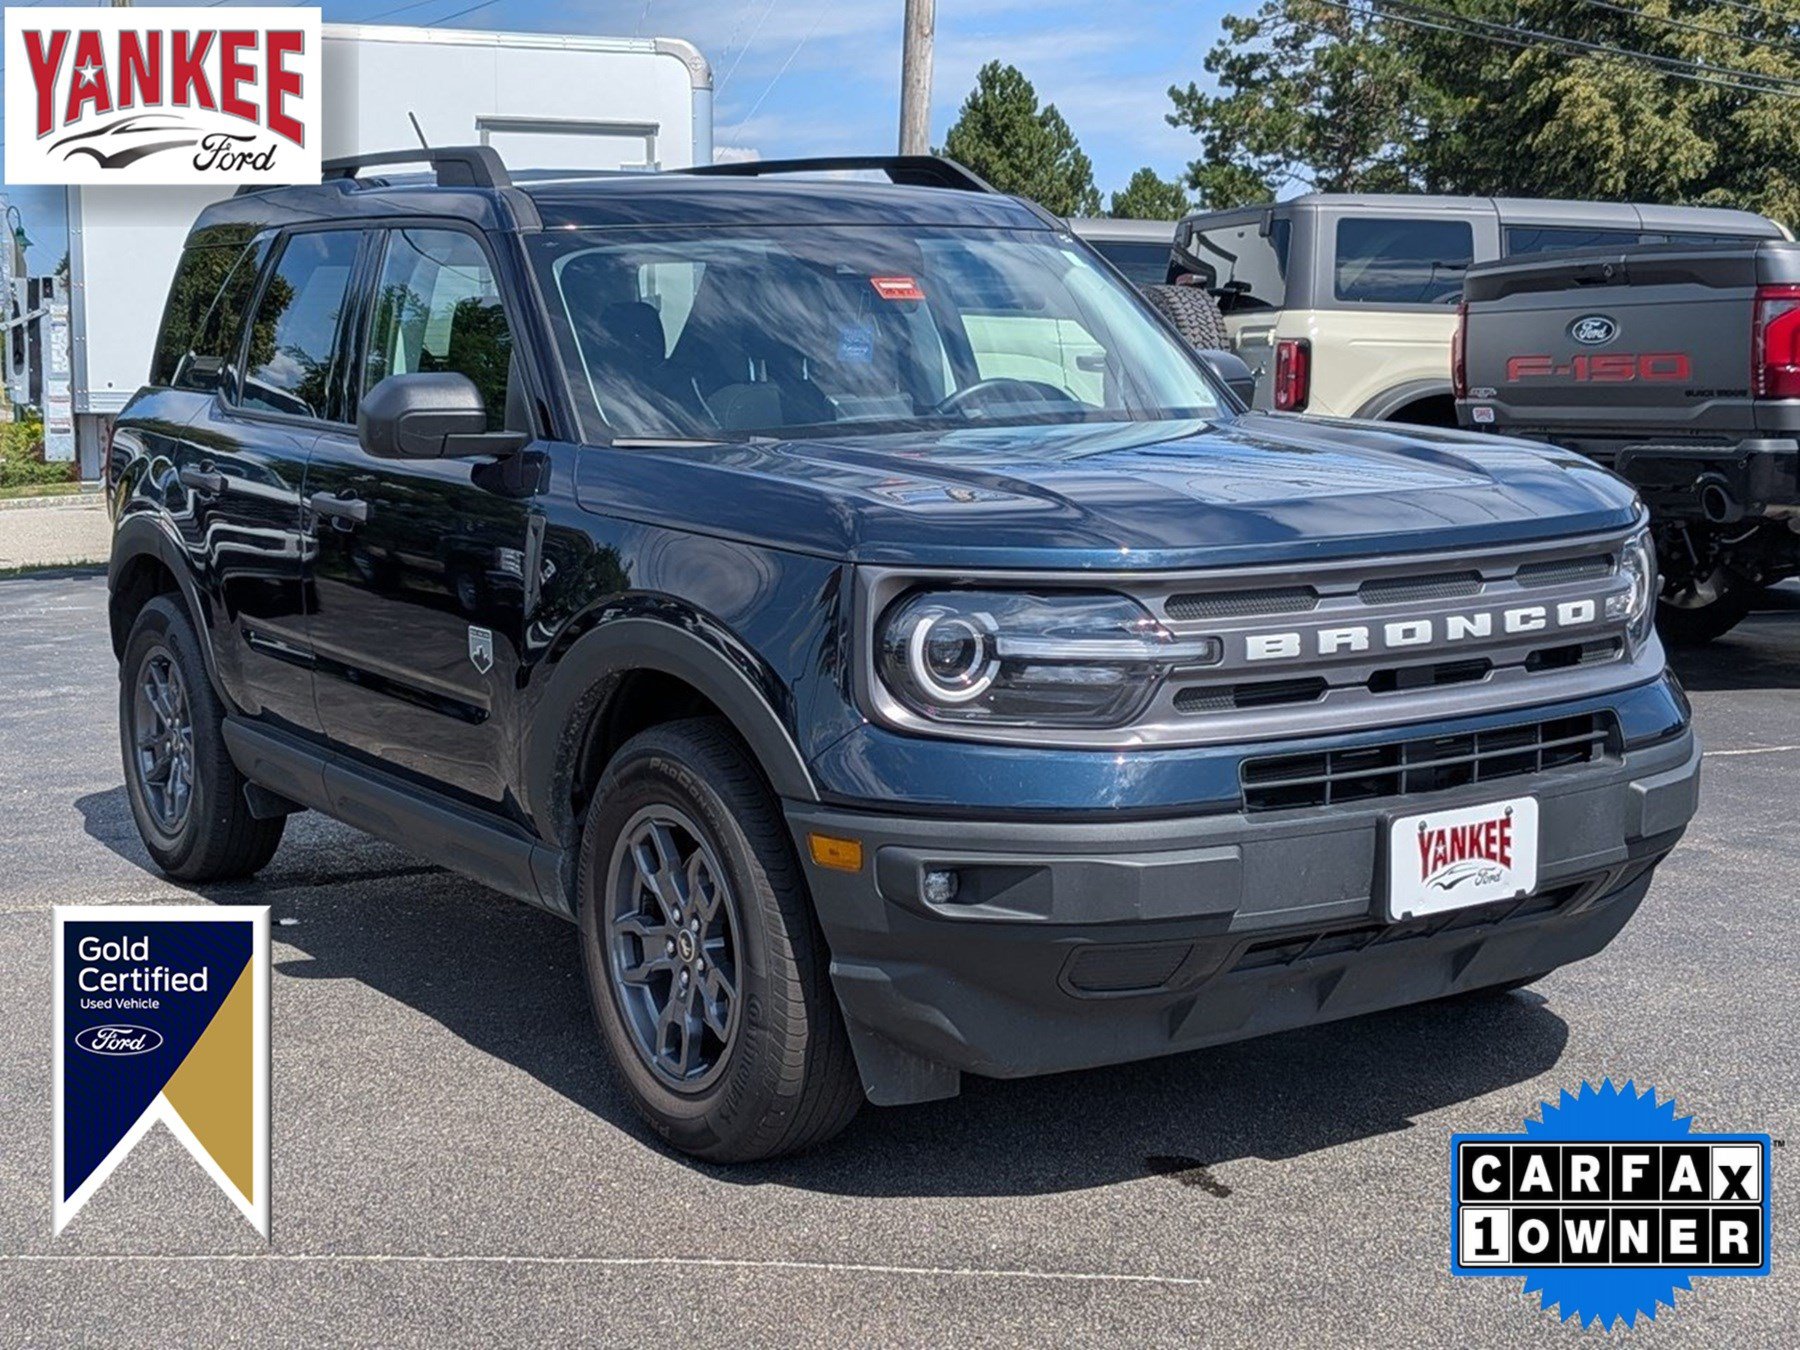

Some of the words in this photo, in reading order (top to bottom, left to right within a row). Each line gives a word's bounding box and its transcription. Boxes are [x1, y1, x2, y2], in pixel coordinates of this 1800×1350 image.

[1580, 317, 1606, 340] Ford
[1507, 353, 1692, 382] F-150
[1246, 599, 1595, 661] BRONCO
[1417, 816, 1512, 882] YANKEE
[1474, 866, 1503, 886] Ford
